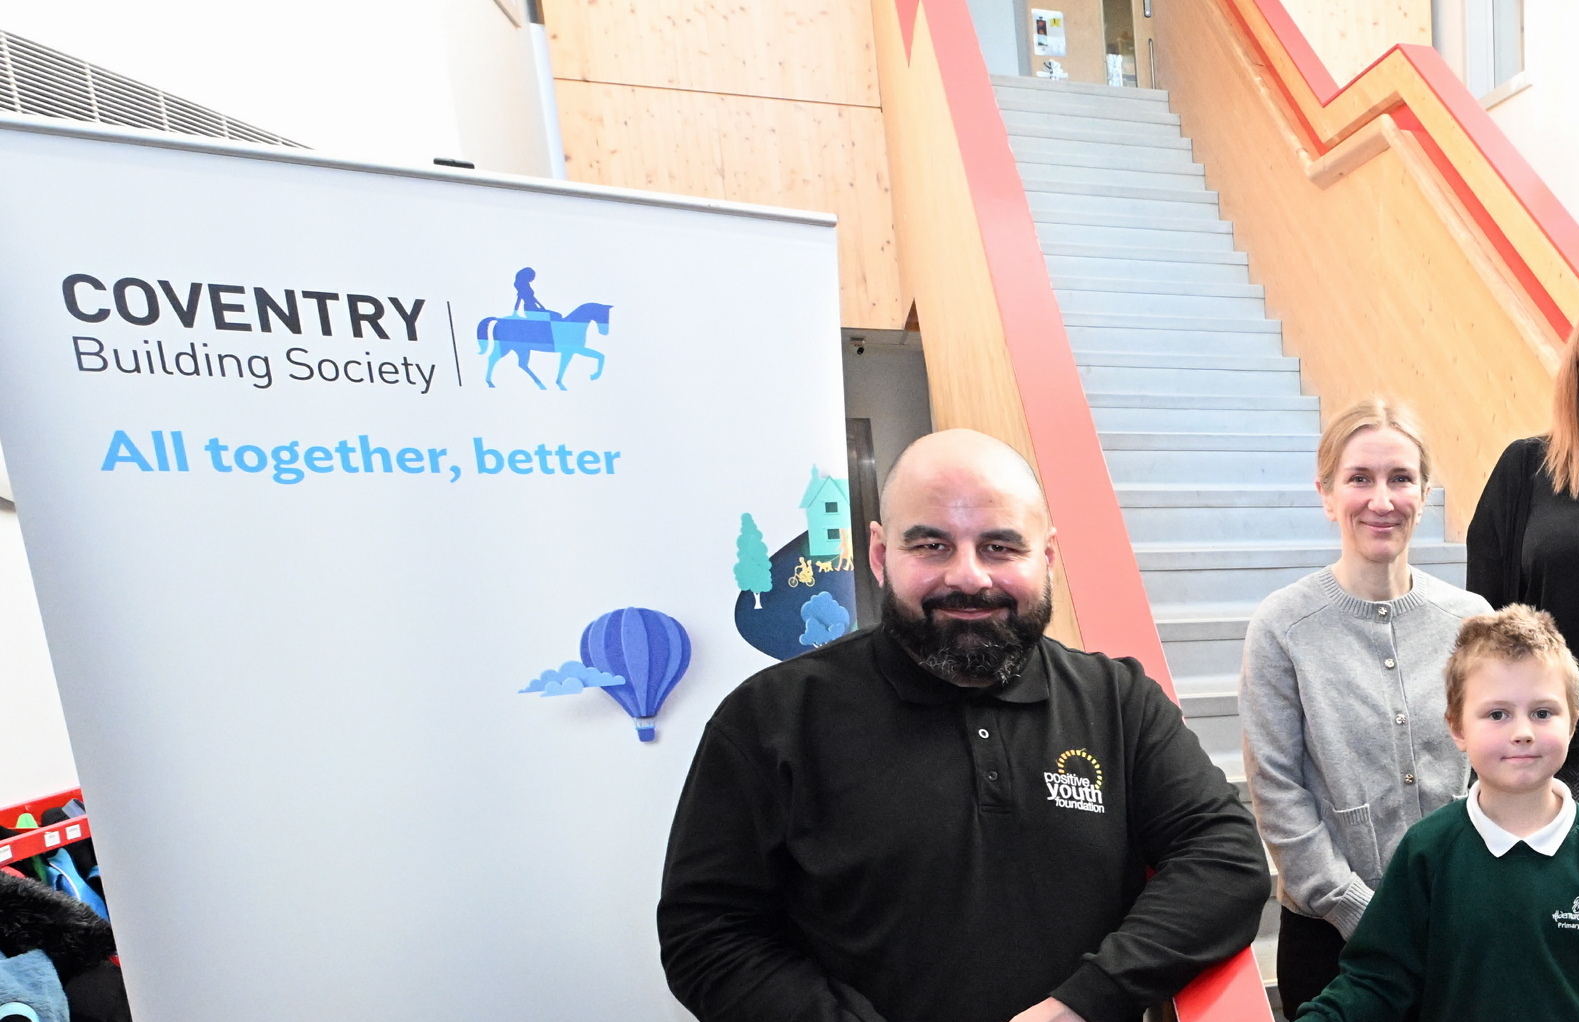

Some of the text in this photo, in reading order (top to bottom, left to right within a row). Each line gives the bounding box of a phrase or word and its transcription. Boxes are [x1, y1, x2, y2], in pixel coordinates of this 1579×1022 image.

[62, 272, 427, 342] COVENTRY
[72, 336, 437, 394] Building Society
[101, 429, 622, 486] All together, better
[1043, 772, 1090, 787] positive
[1046, 782, 1103, 803] youth
[1055, 797, 1105, 813] foundation
